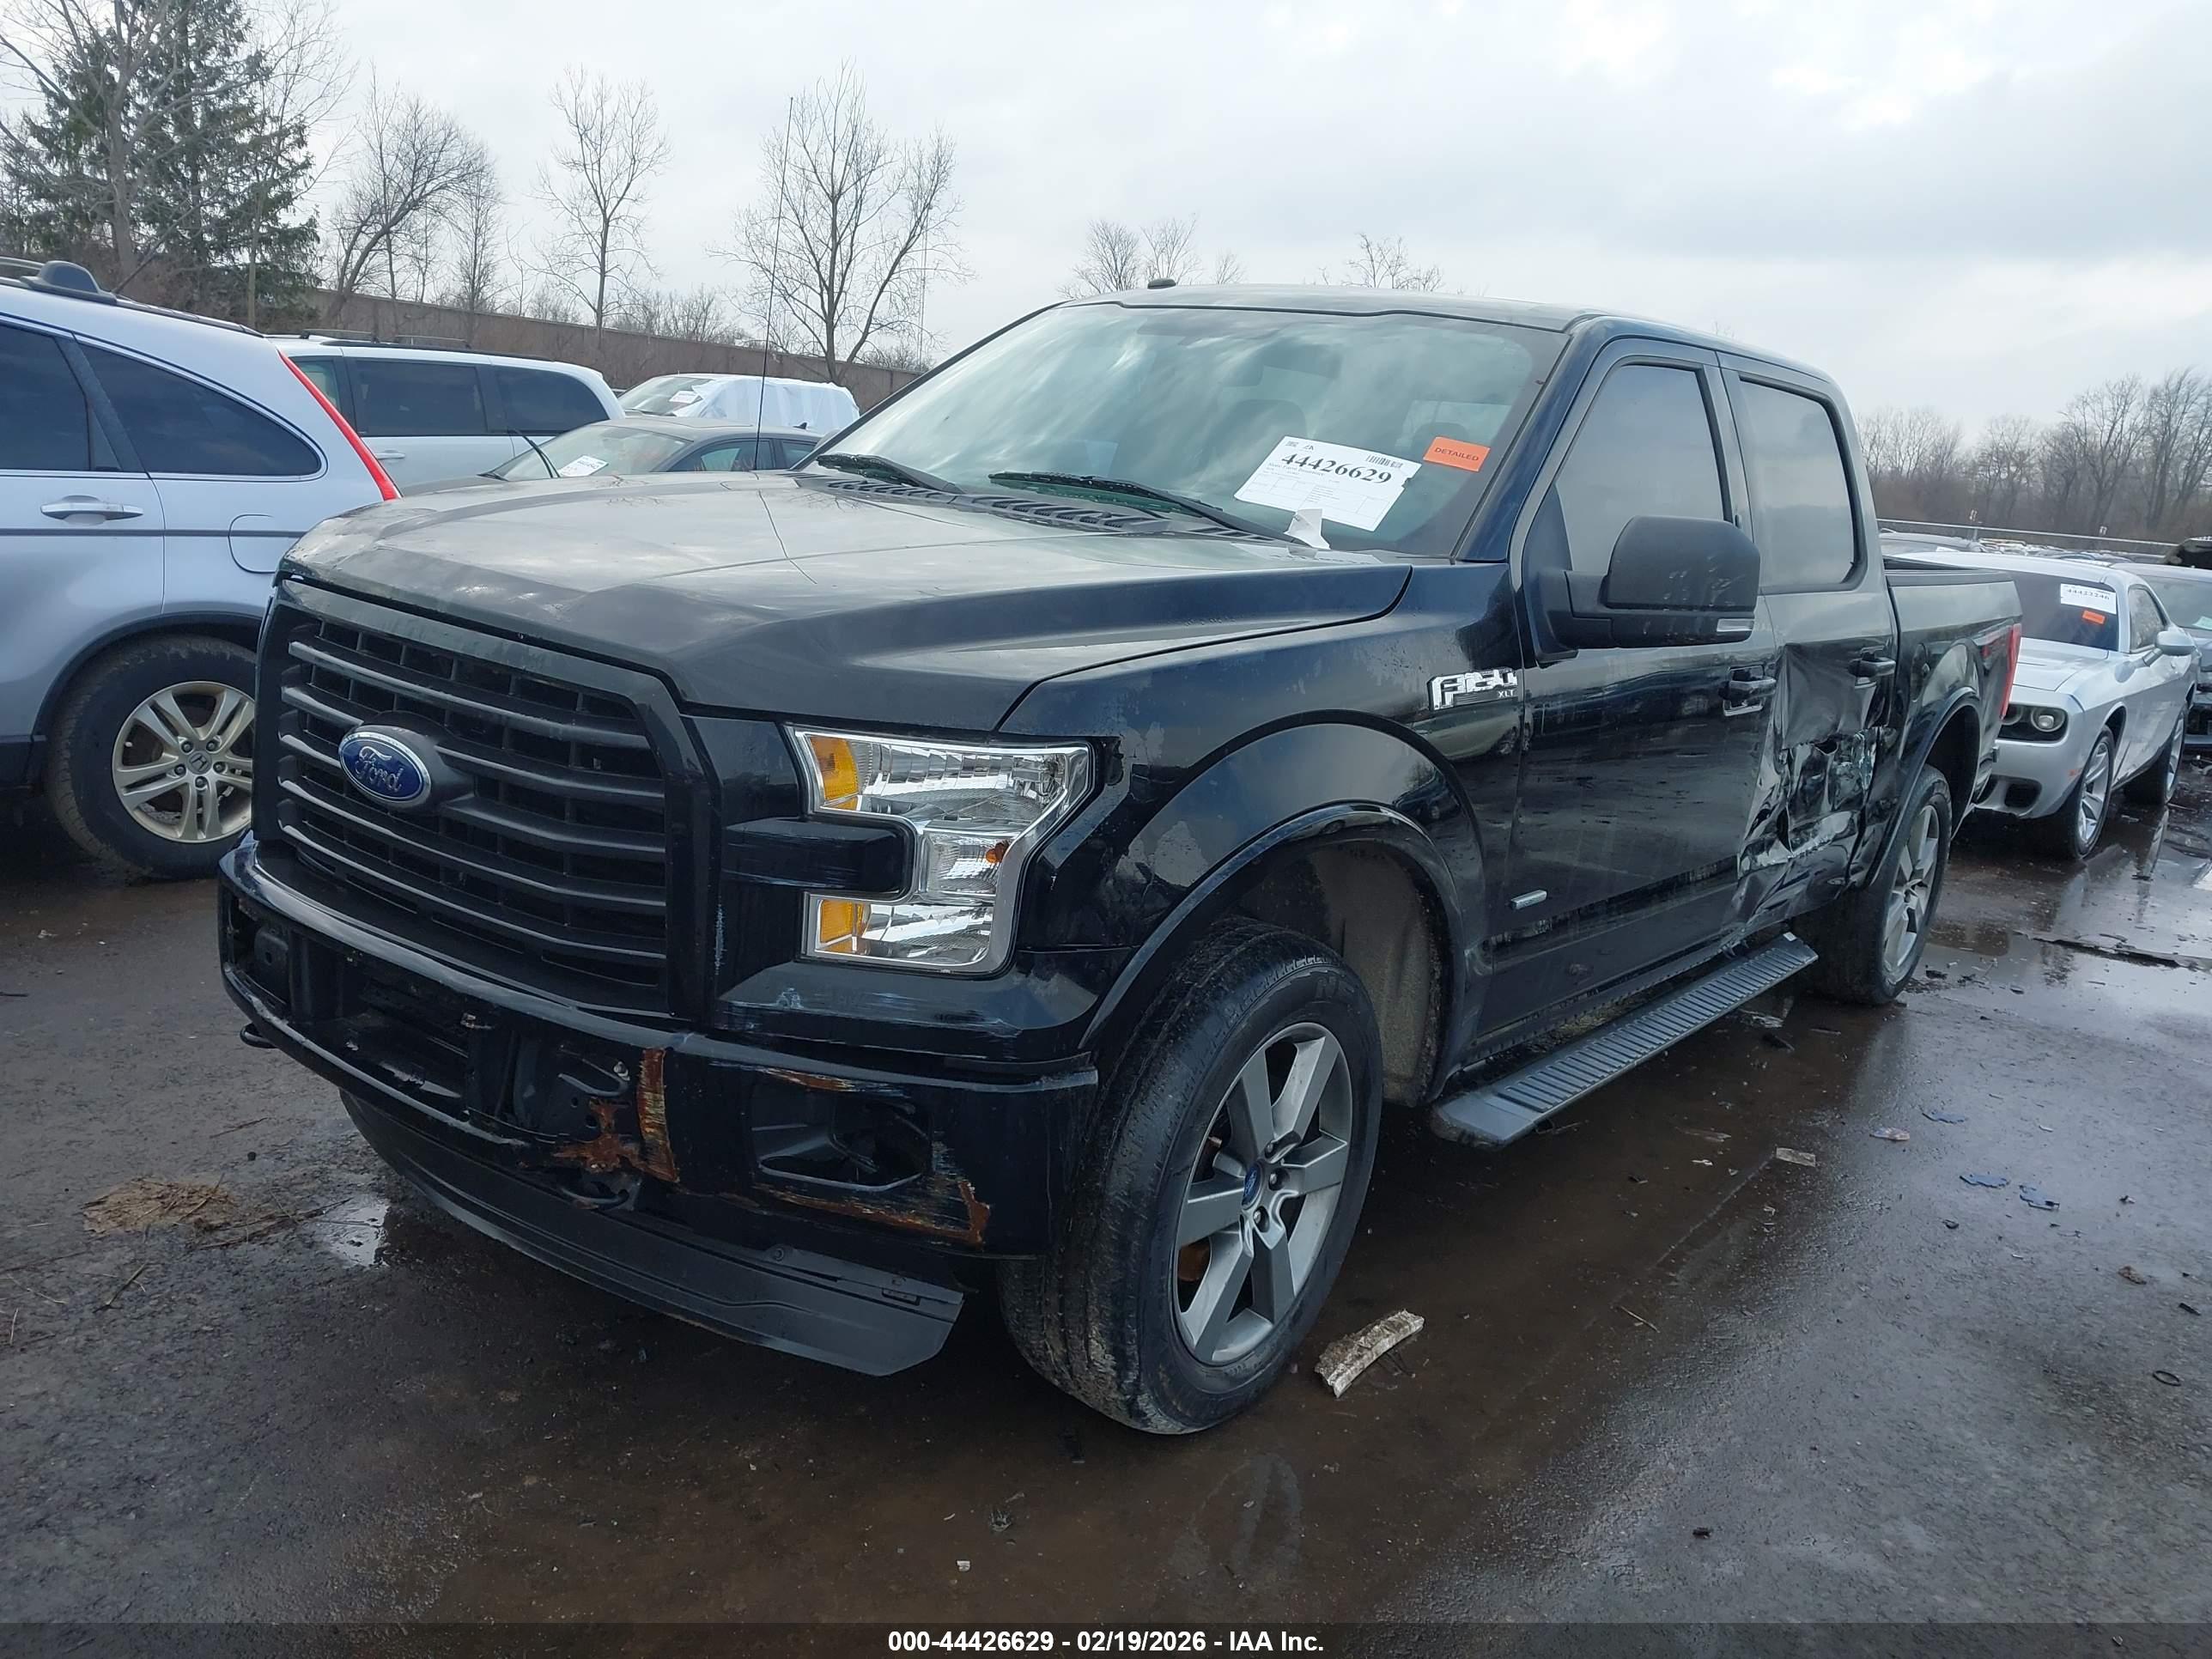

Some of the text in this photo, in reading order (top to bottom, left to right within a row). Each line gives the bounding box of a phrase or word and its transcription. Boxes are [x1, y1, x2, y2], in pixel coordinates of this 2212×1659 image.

[1435, 447, 1480, 462] DETAILED
[1281, 453, 1391, 483] 44426629
[1498, 689, 1515, 698] XLT
